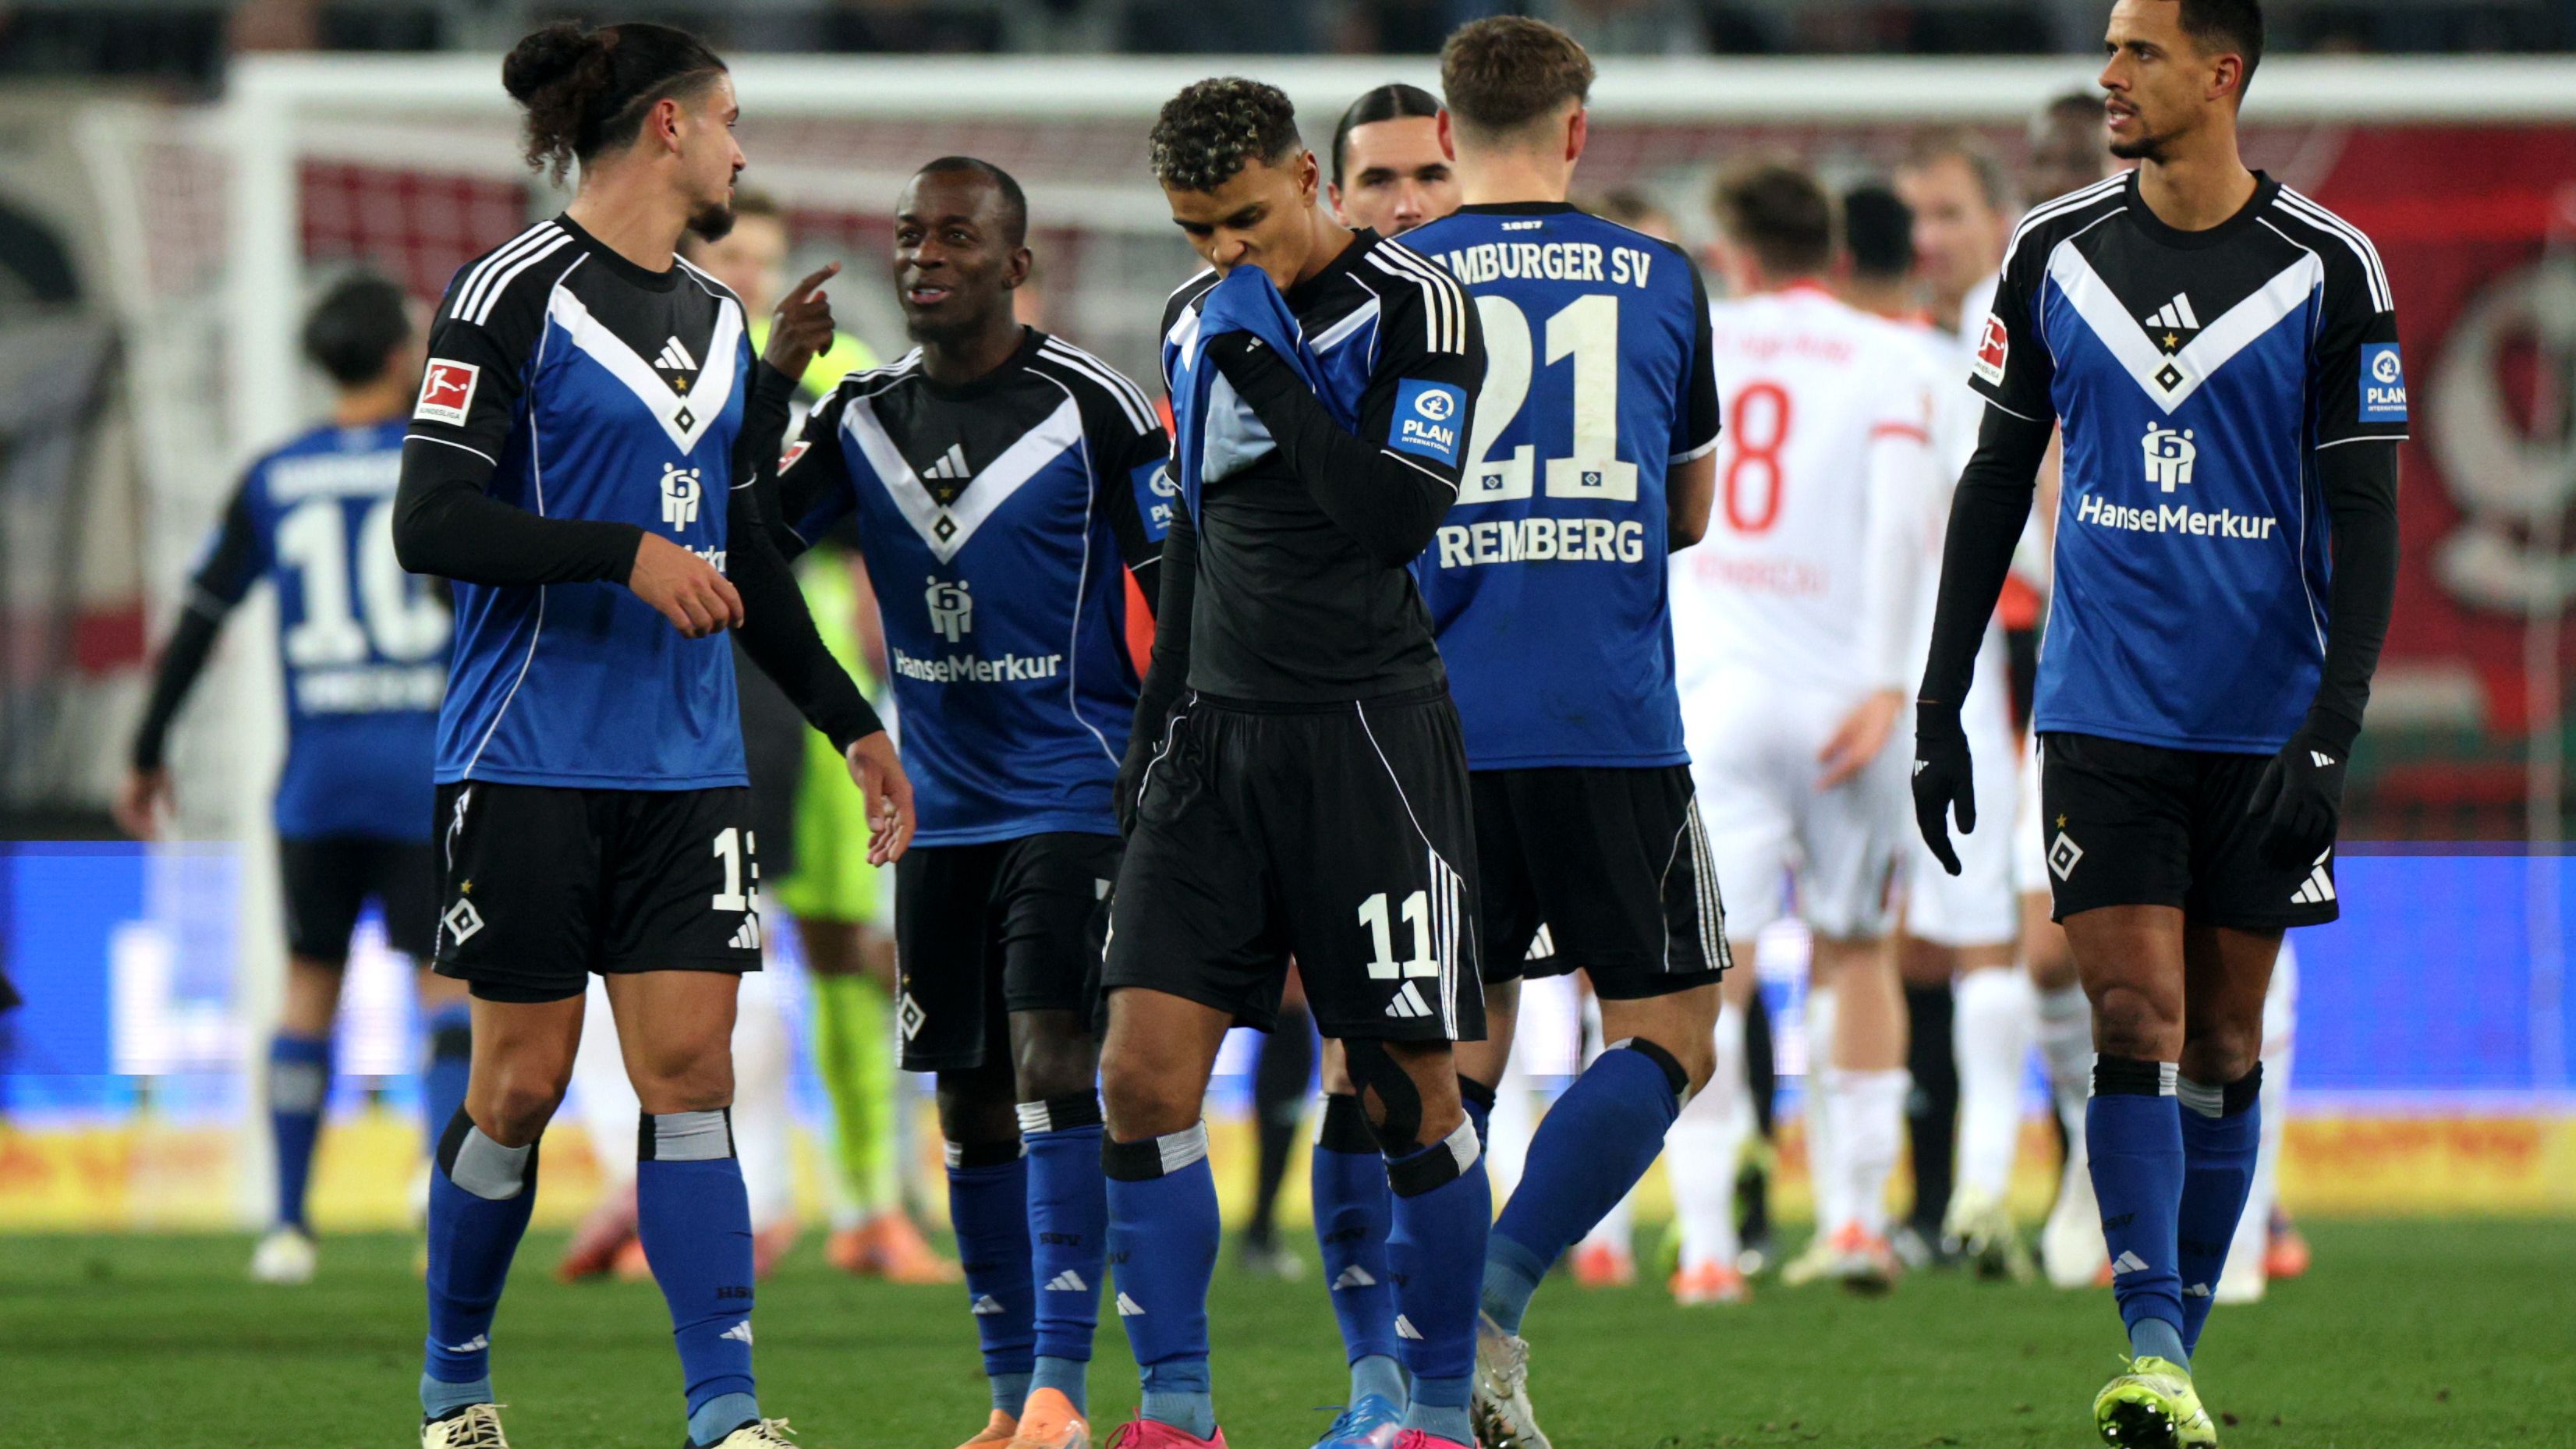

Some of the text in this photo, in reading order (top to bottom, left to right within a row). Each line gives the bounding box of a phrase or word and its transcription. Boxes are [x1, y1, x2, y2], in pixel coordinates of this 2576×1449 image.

[1611, 246, 1651, 289] SV
[1455, 294, 1638, 505] 21
[2368, 387, 2407, 404] PLAN
[1402, 420, 1454, 446] PLAN
[1724, 377, 1794, 536] 8
[2077, 494, 2276, 539] HanseMerkur
[1436, 518, 1642, 569] REMBERG
[893, 647, 1061, 682] HanseMerkur
[1358, 891, 1438, 979] 11
